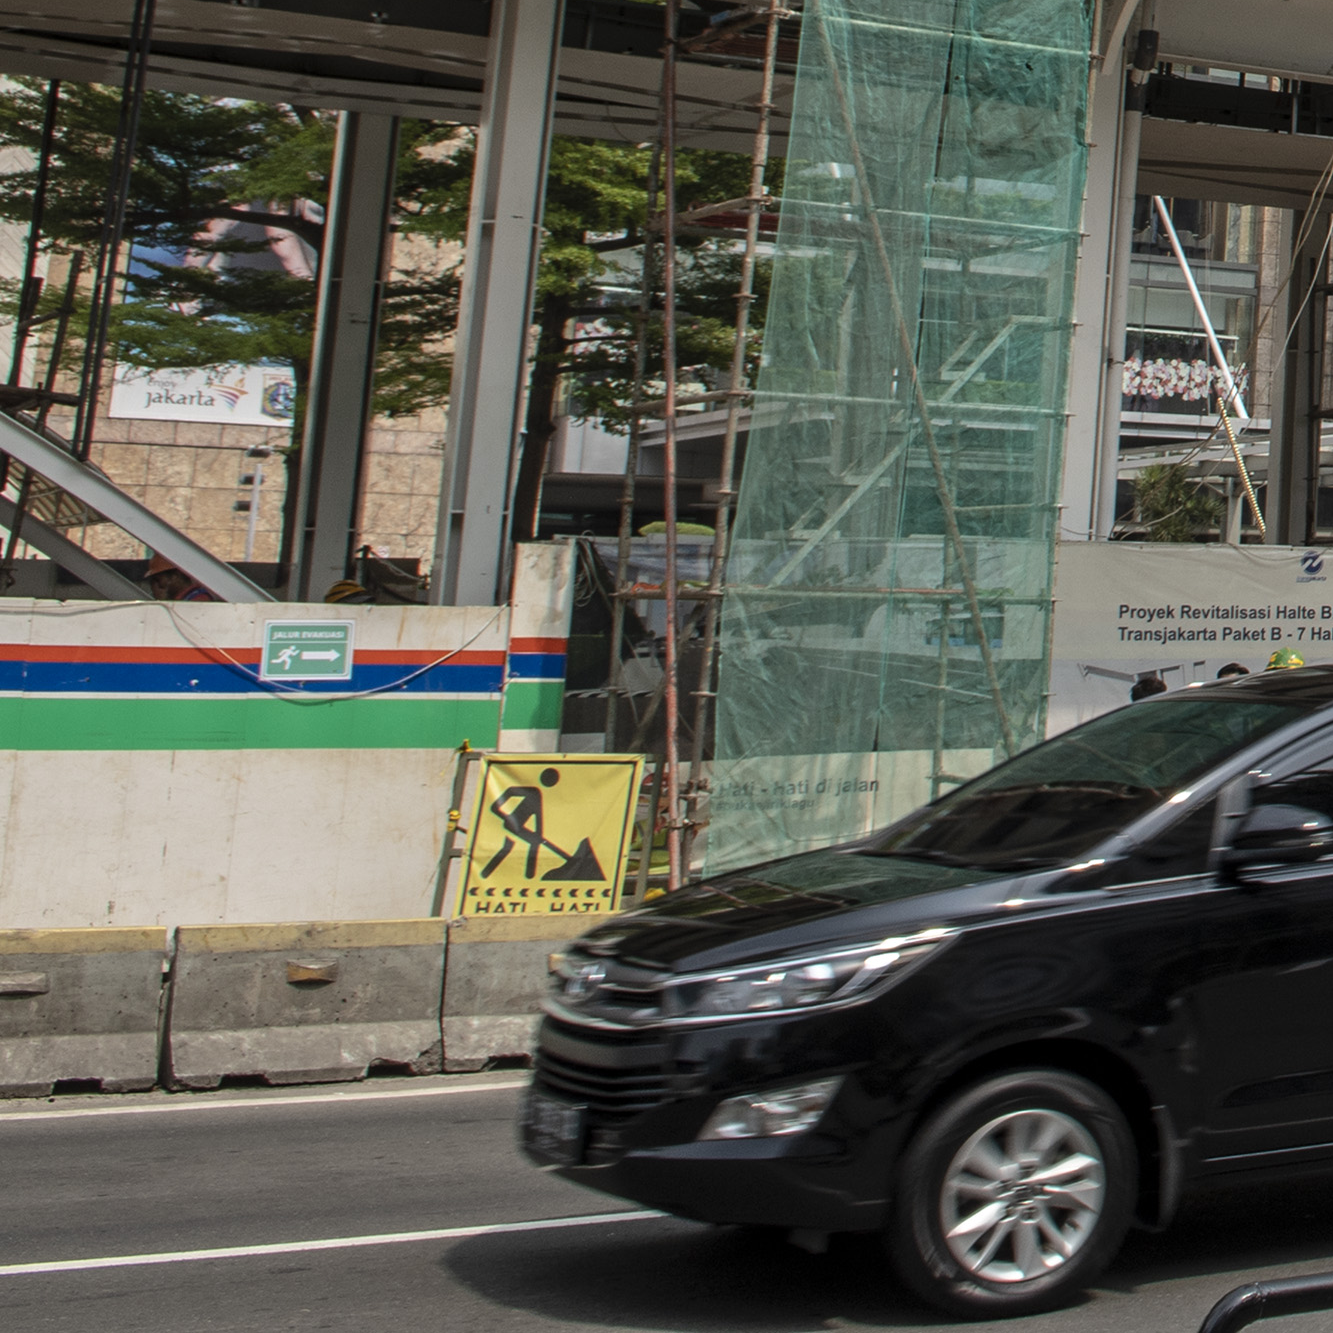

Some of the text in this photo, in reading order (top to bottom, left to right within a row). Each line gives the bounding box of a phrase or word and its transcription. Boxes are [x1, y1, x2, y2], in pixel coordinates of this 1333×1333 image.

[143, 388, 216, 408] jakarta
[1118, 604, 1176, 622] Proyek
[1180, 605, 1271, 619] Revitalisasi
[1276, 605, 1316, 620] Halte
[272, 630, 345, 640] JALUR EVAKUASI
[1118, 626, 1217, 645] Transjakarta
[1222, 627, 1266, 641] Paket
[1271, 627, 1282, 641] B
[1297, 627, 1306, 642] 7
[718, 782, 756, 798] Hati
[774, 778, 809, 795] hati
[815, 776, 832, 794] di
[834, 776, 880, 797] jalan
[475, 901, 527, 913] HATI
